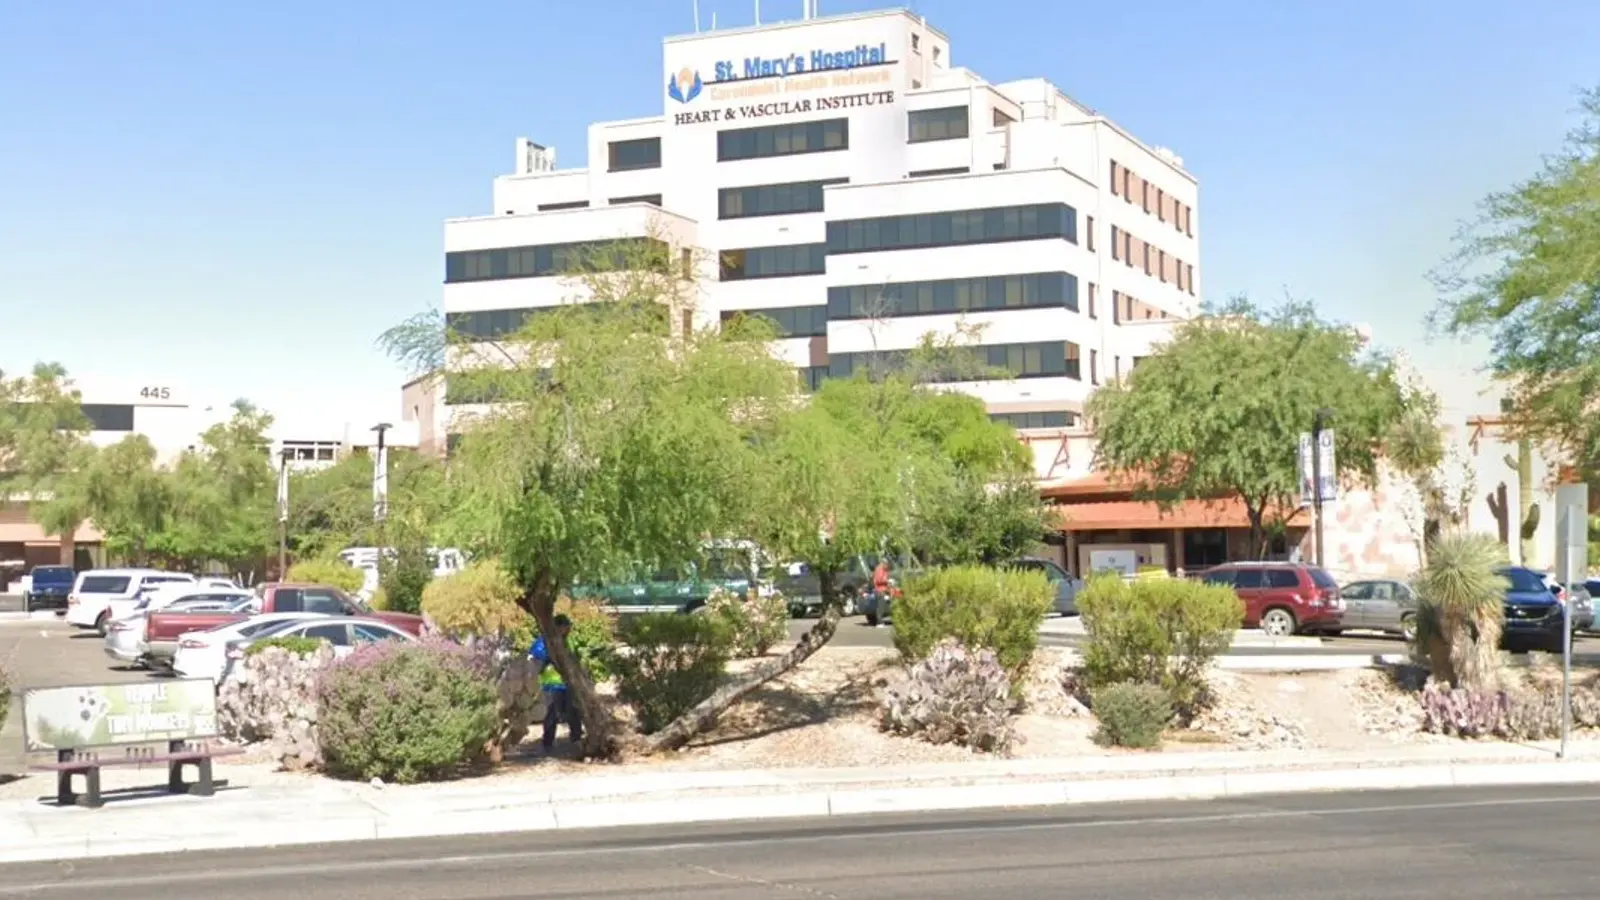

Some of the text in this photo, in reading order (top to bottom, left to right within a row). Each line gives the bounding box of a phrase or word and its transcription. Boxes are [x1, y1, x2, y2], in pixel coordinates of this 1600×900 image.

[715, 42, 886, 82] St. Mary's Hospital
[674, 91, 895, 126] HEART & VASCULAR INSTITUTE
[140, 386, 170, 400] 445
